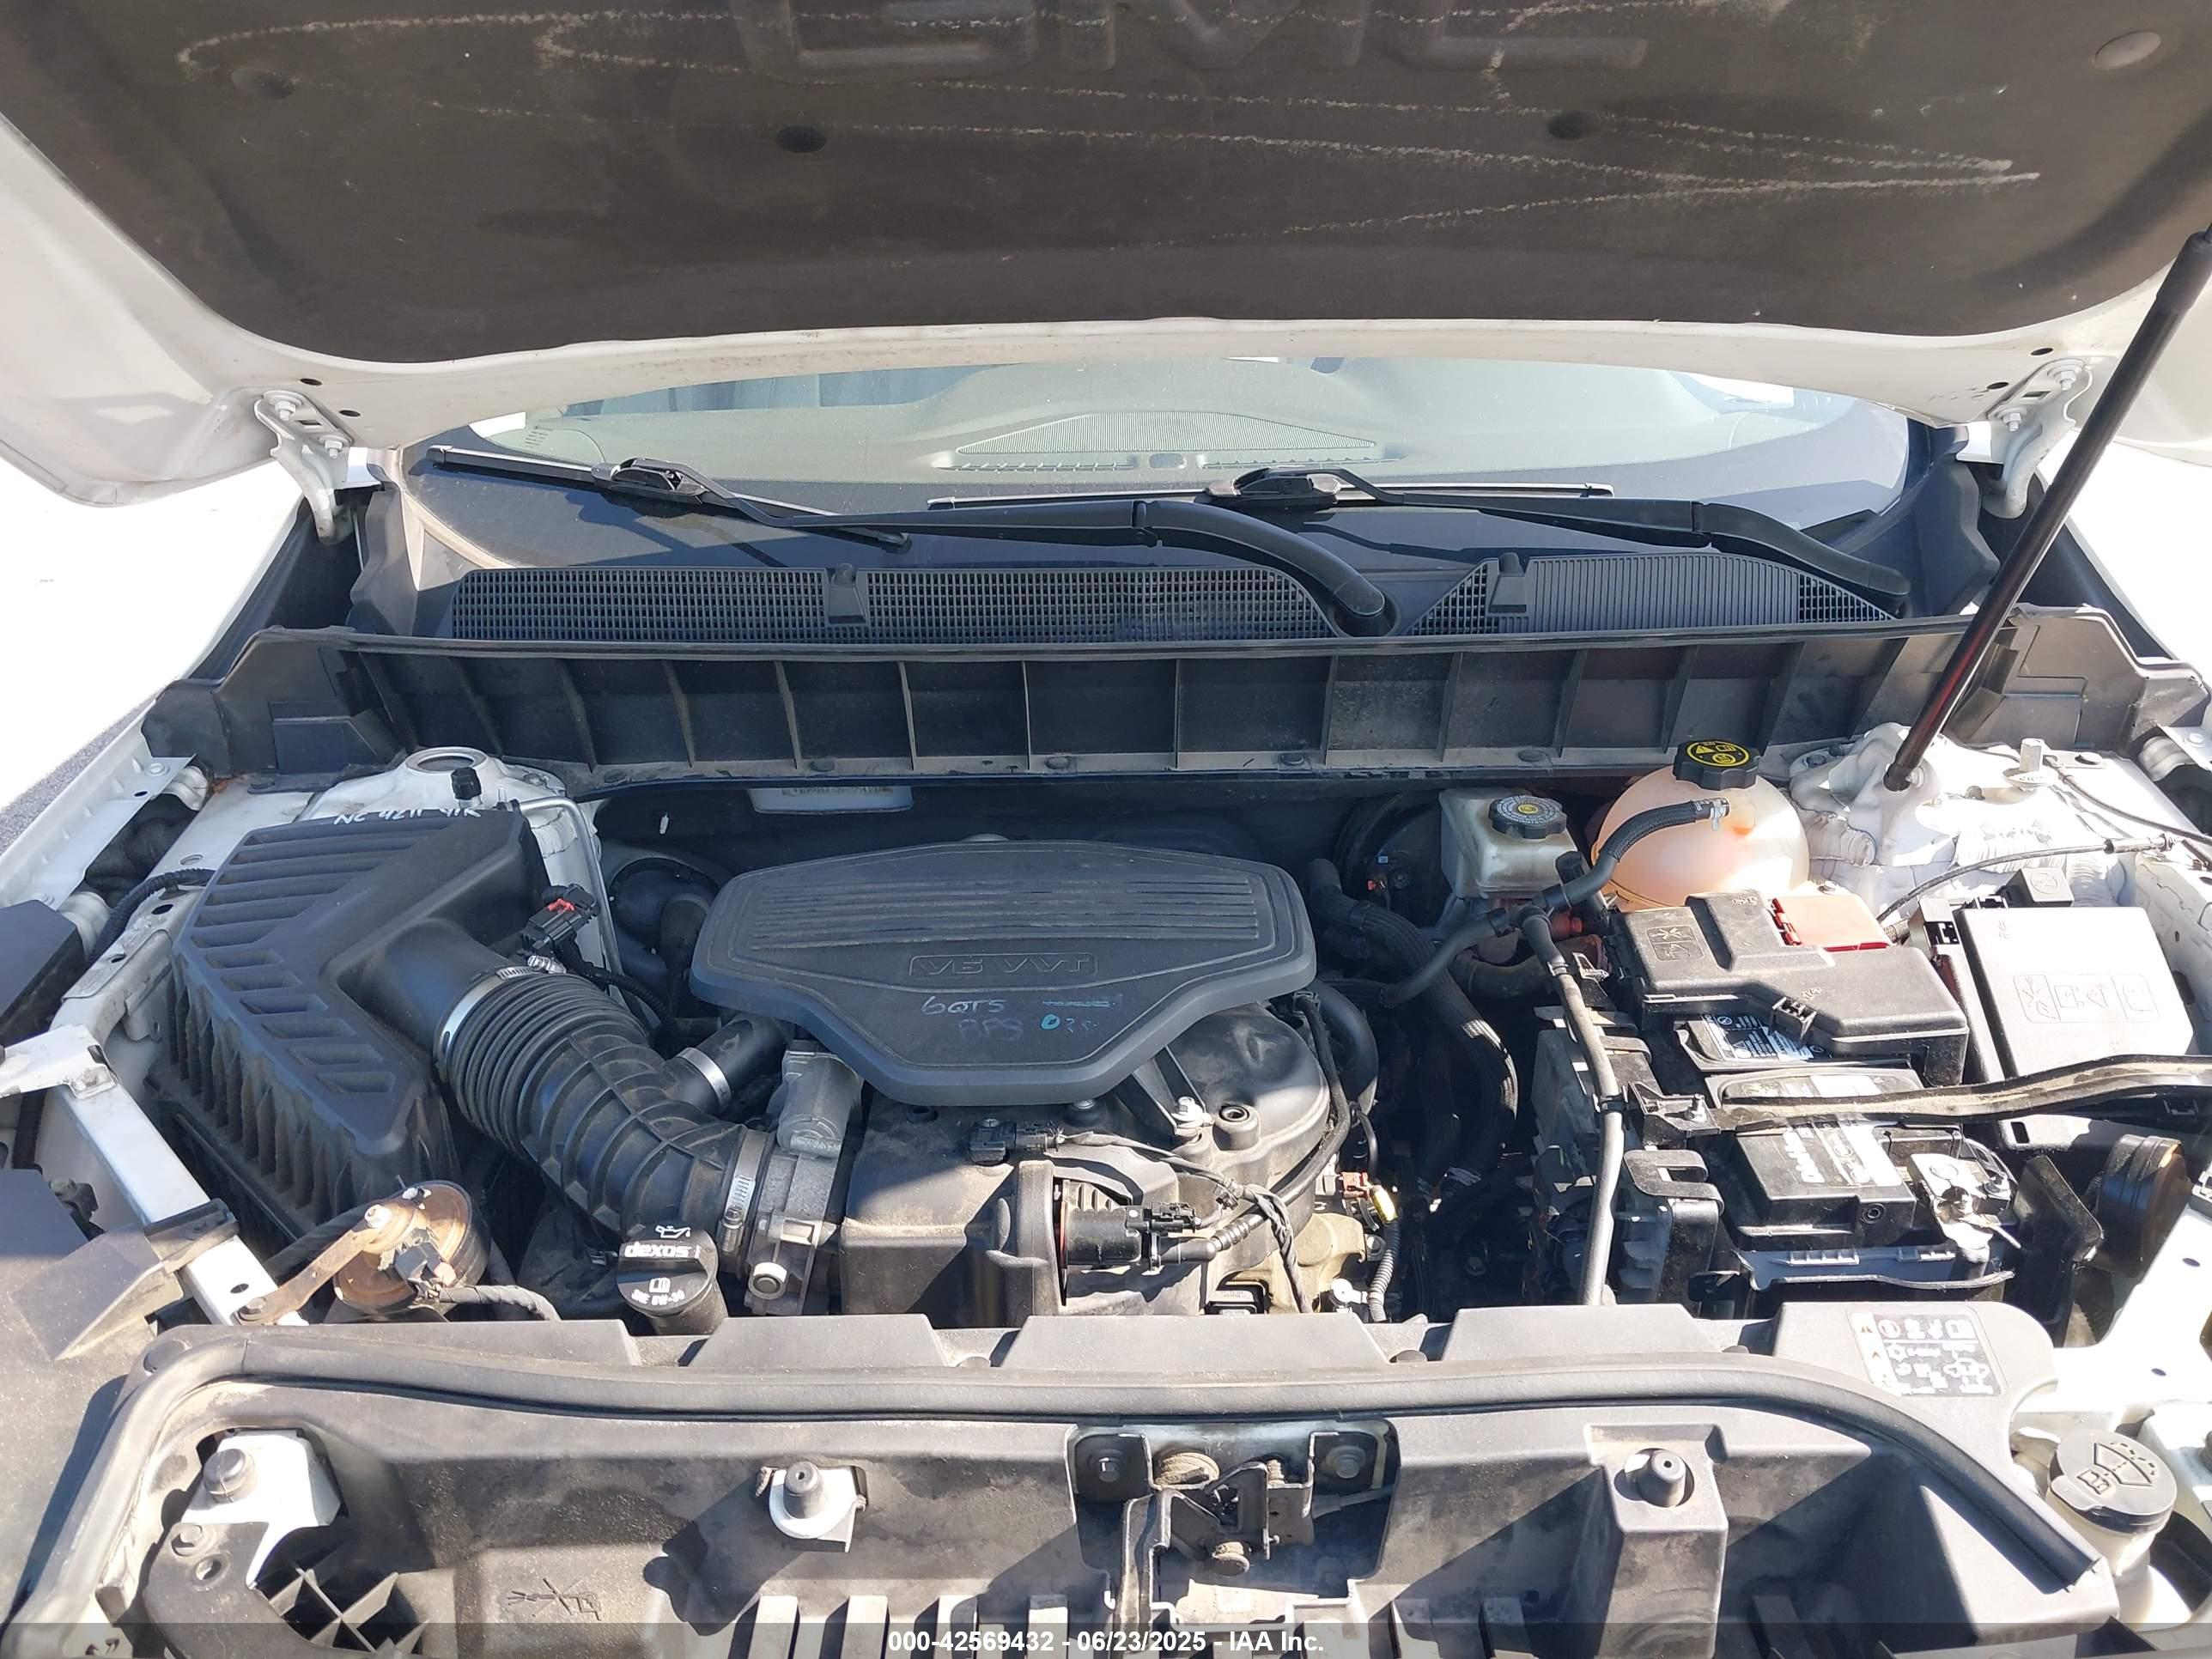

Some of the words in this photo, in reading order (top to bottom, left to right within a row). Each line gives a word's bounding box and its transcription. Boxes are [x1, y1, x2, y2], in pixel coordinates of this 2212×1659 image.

[917, 957, 983, 975] V6
[996, 957, 1091, 974] VVT
[623, 1241, 692, 1259] dexos
